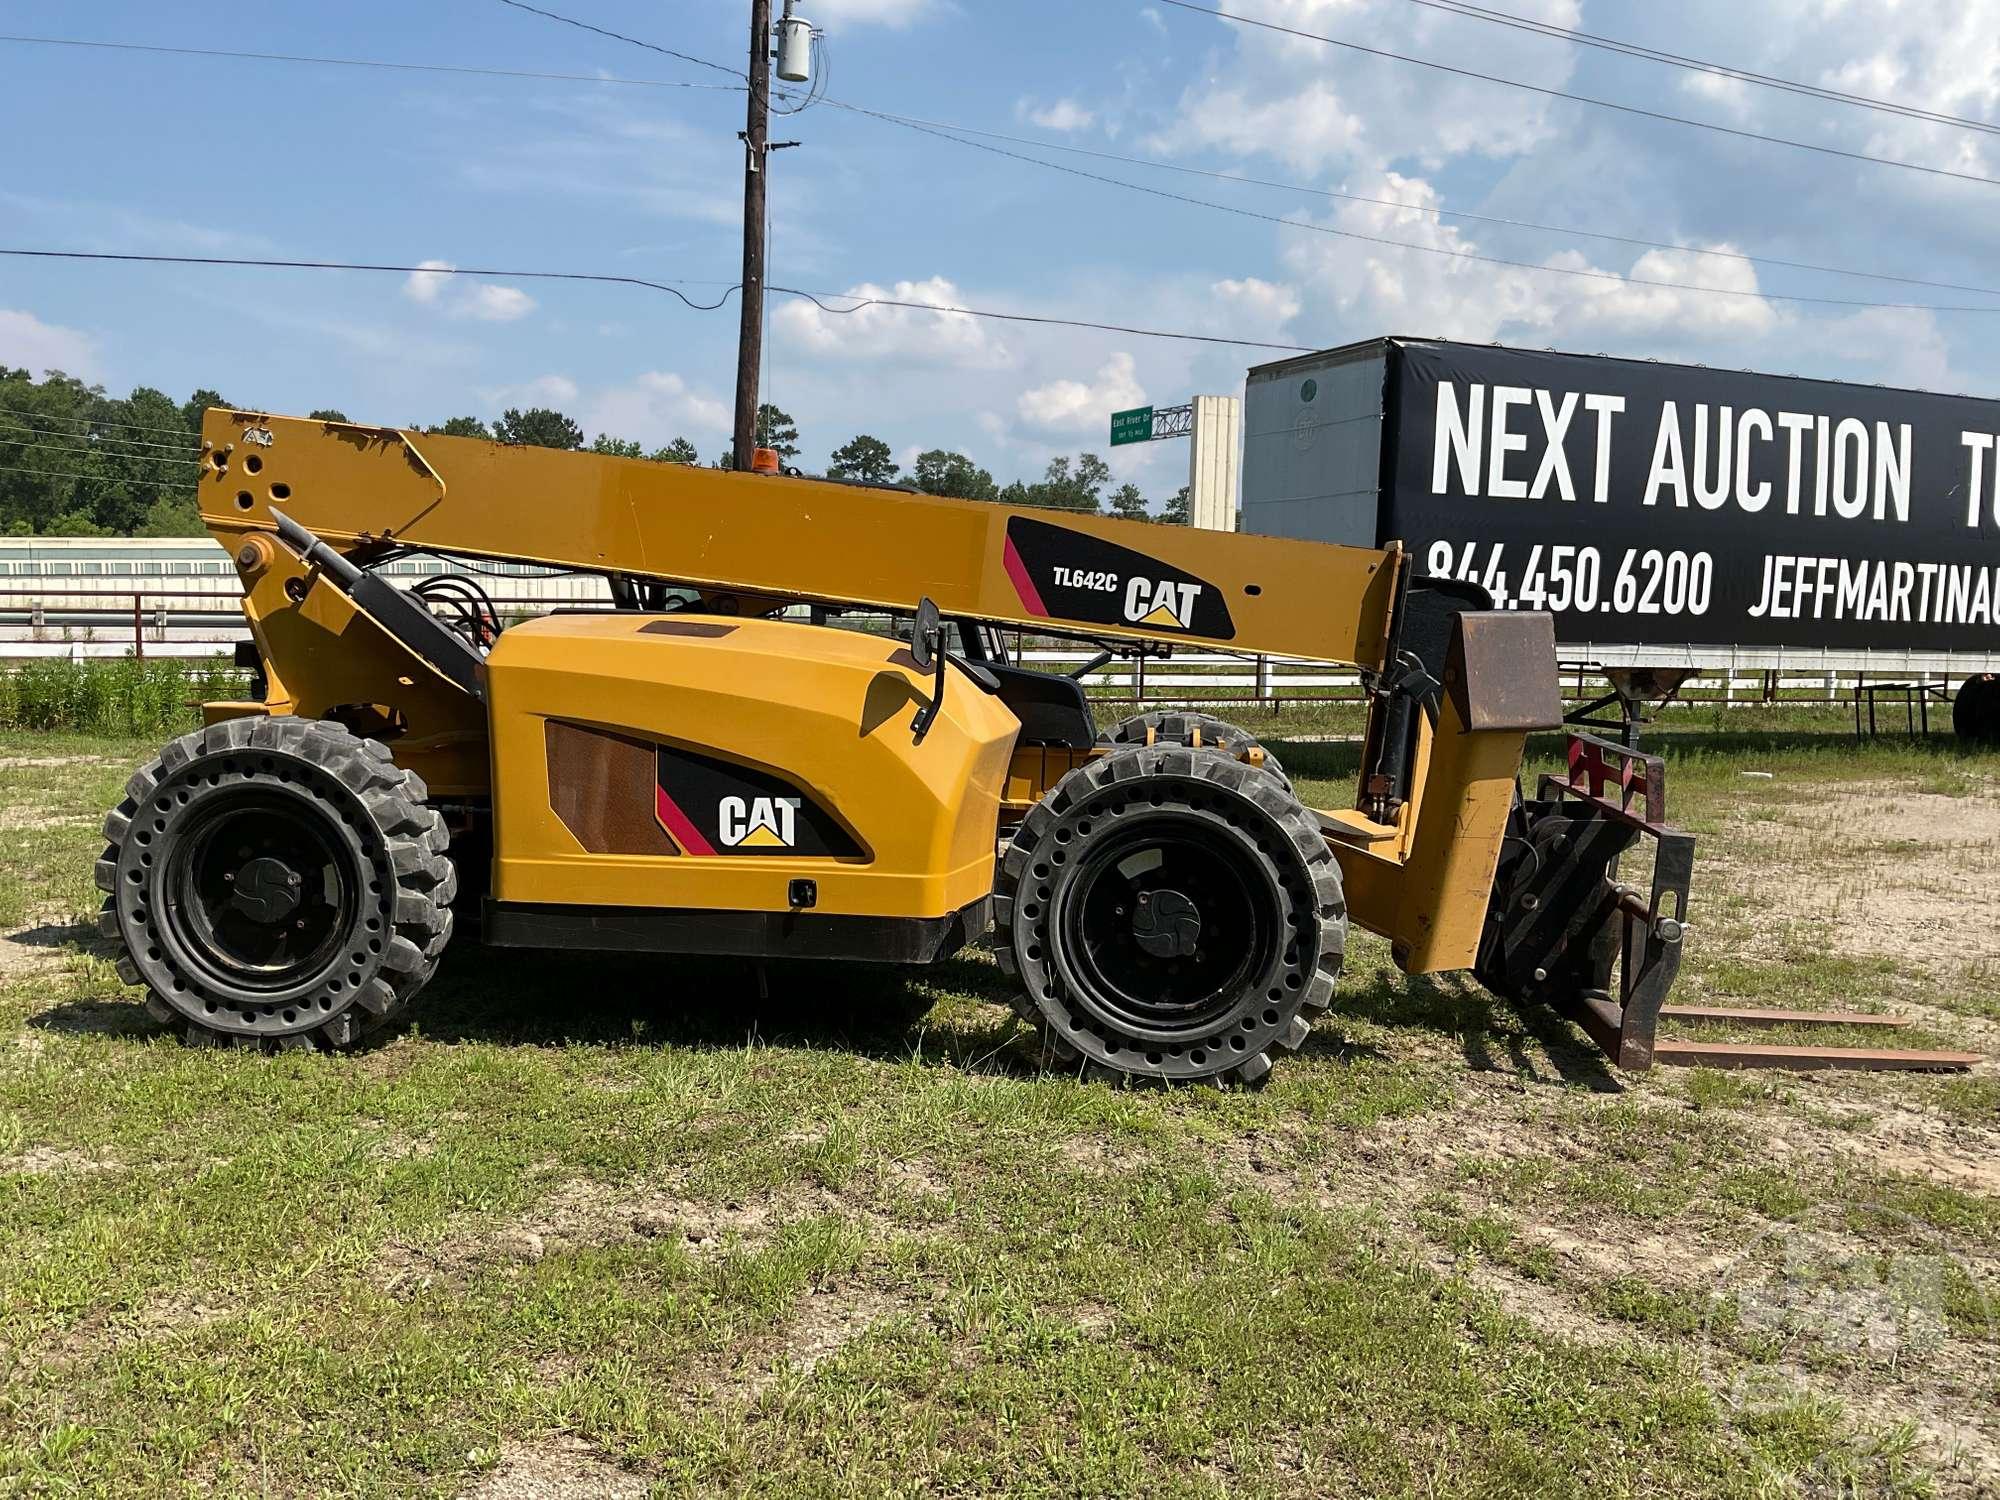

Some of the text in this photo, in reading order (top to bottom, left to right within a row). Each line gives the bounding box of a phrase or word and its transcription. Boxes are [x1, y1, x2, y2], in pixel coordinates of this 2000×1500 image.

[1431, 380, 2000, 533] NEXT AUCTION T
[1053, 566, 1202, 630] TL642C CAT
[718, 796, 801, 847] CAT
